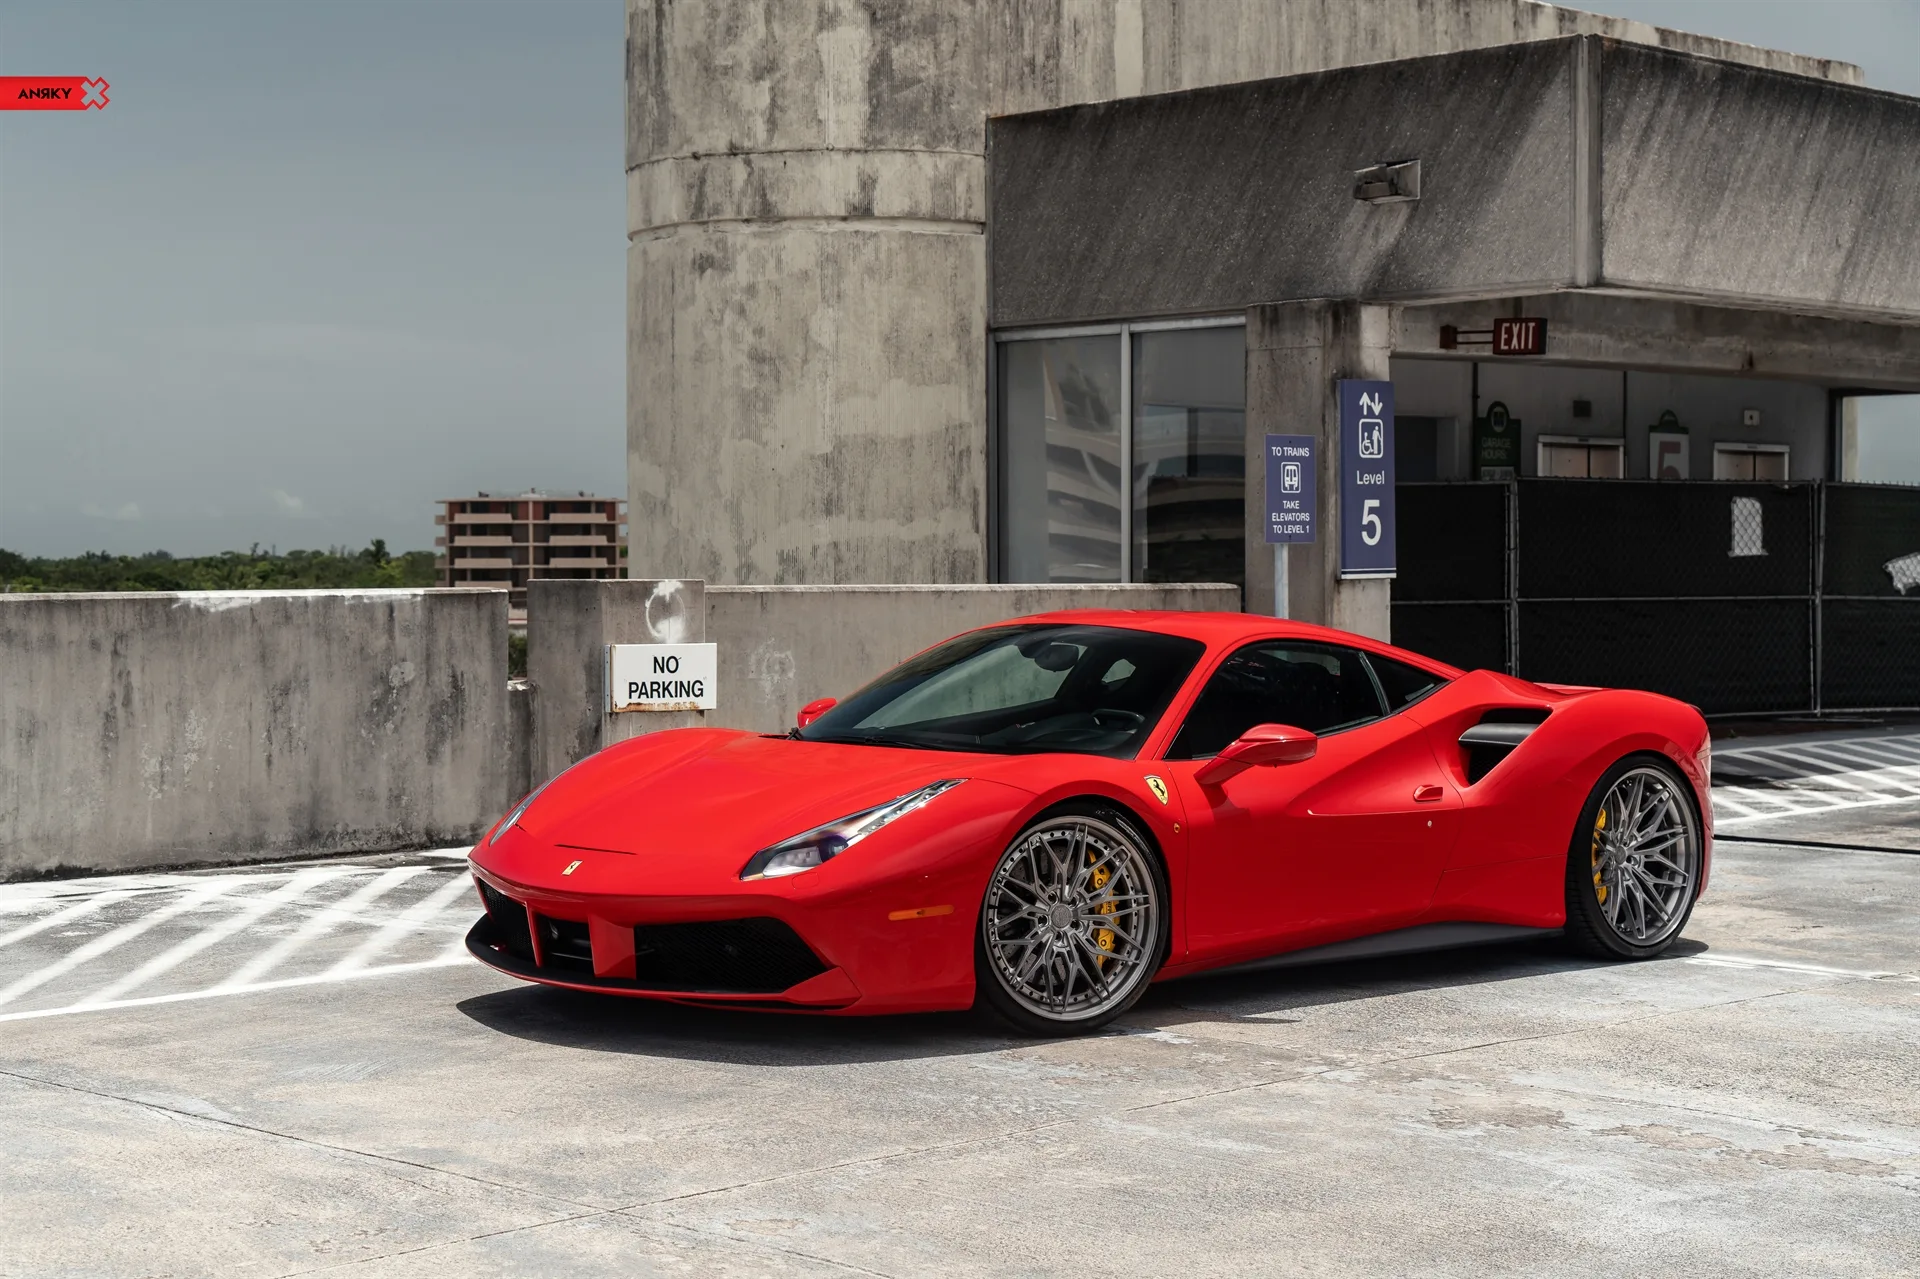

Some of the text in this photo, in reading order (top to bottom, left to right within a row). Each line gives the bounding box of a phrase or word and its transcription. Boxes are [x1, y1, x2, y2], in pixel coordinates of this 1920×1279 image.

[1500, 322, 1536, 350] EXIT
[1481, 437, 1511, 448] GARAGE
[1272, 446, 1310, 457] TO TRAINS
[1356, 470, 1385, 485] Level
[1283, 500, 1300, 509] TAKE
[1272, 512, 1310, 522] ELEVATORS
[1361, 499, 1382, 546] 5
[1273, 525, 1310, 534] TO LEVEL 1
[653, 655, 679, 674] NO
[628, 680, 704, 699] PARKING
